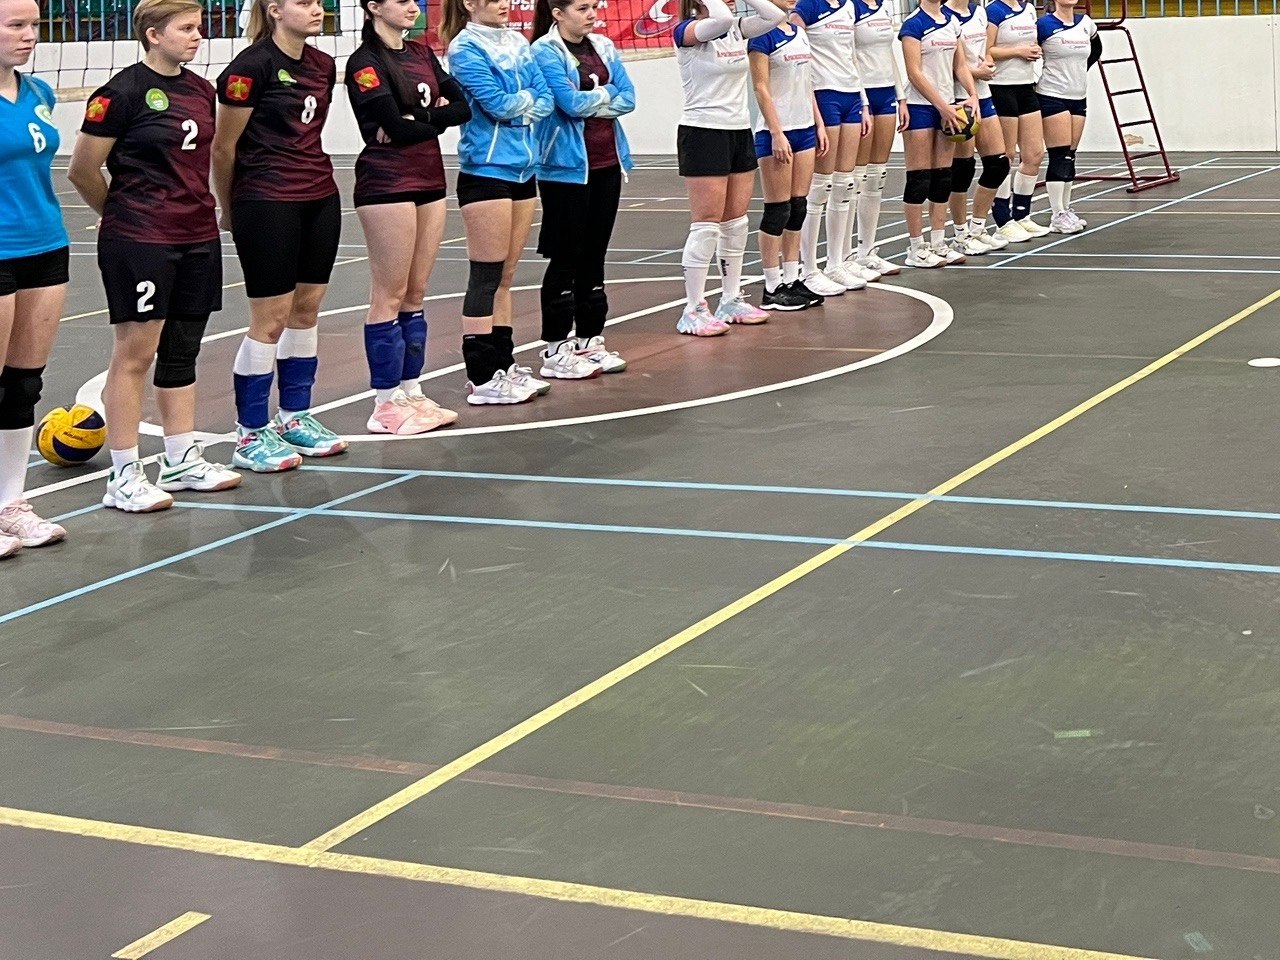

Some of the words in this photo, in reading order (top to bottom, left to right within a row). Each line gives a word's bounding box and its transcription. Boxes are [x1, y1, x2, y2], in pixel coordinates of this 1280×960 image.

[301, 95, 318, 125] 8
[417, 82, 431, 108] 3
[28, 122, 47, 153] 6
[181, 119, 199, 150] 2
[136, 280, 156, 313] 2
